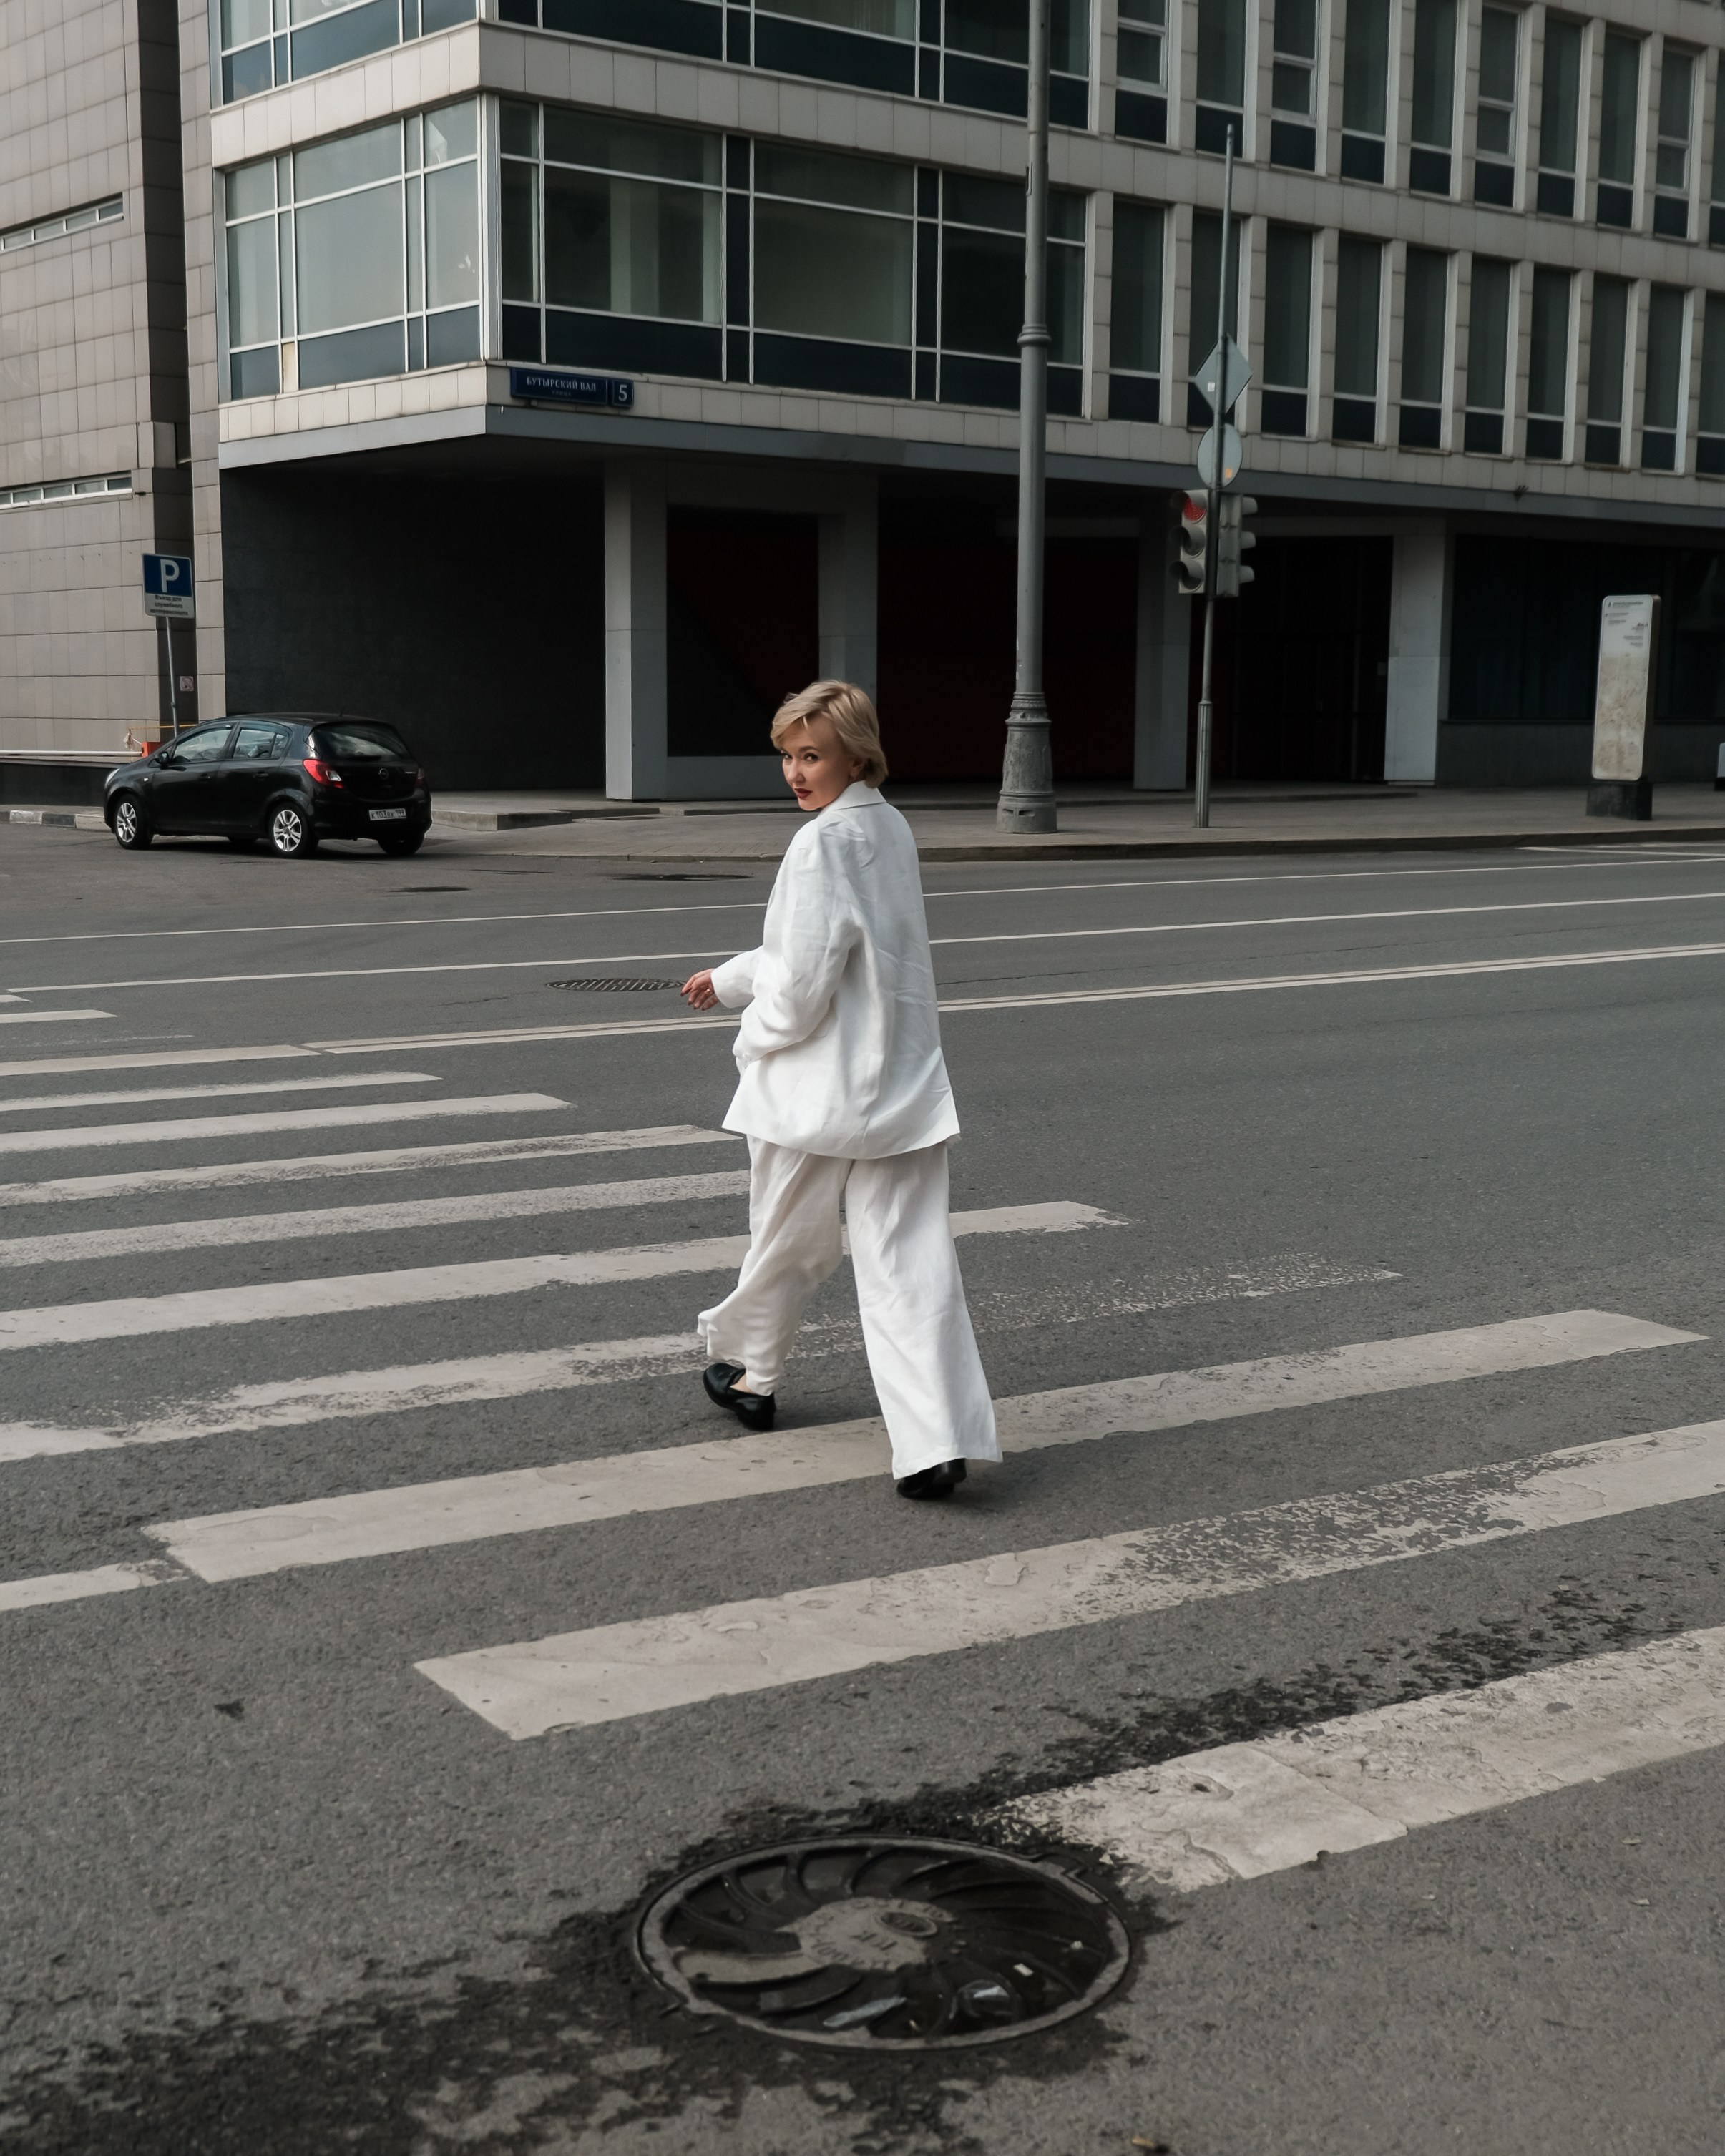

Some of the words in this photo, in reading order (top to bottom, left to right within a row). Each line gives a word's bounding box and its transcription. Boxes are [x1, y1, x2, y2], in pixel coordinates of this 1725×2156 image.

[527, 376, 577, 390] БУТЫРСКИЙ
[580, 382, 596, 392] ВАЛ
[618, 384, 627, 401] 5
[160, 559, 180, 593] P
